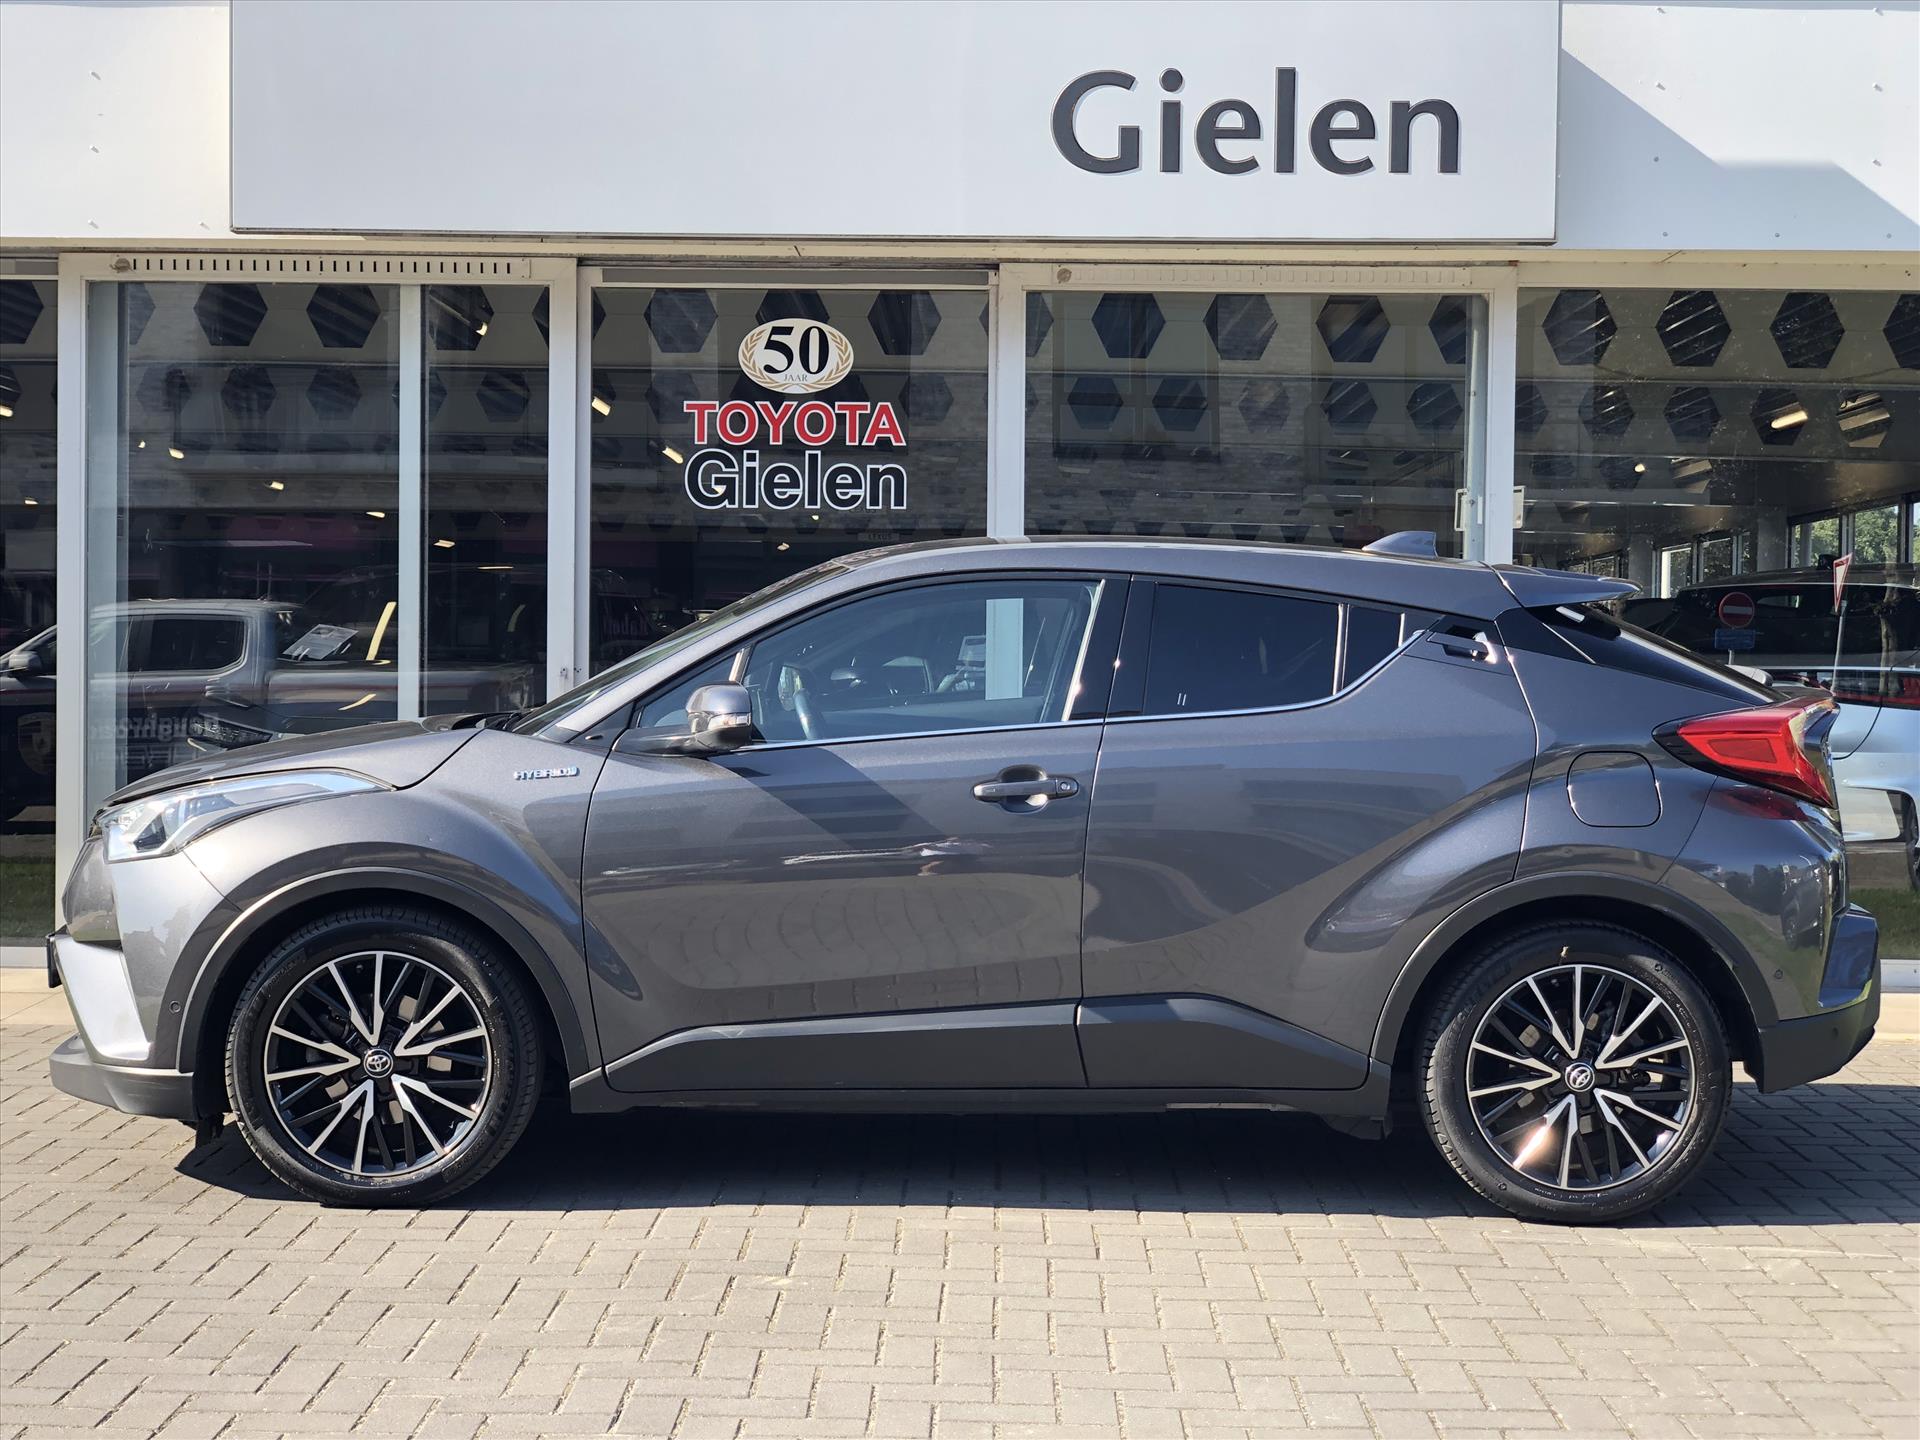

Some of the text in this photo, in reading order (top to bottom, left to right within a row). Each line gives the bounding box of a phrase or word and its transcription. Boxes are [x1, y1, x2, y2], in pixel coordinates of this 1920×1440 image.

[1051, 67, 1461, 175] Gielen
[763, 326, 829, 374] 50
[783, 373, 808, 382] JAAR
[684, 400, 907, 446] TOYOTA
[684, 448, 908, 510] Gielen
[513, 766, 569, 780] HYBRID
